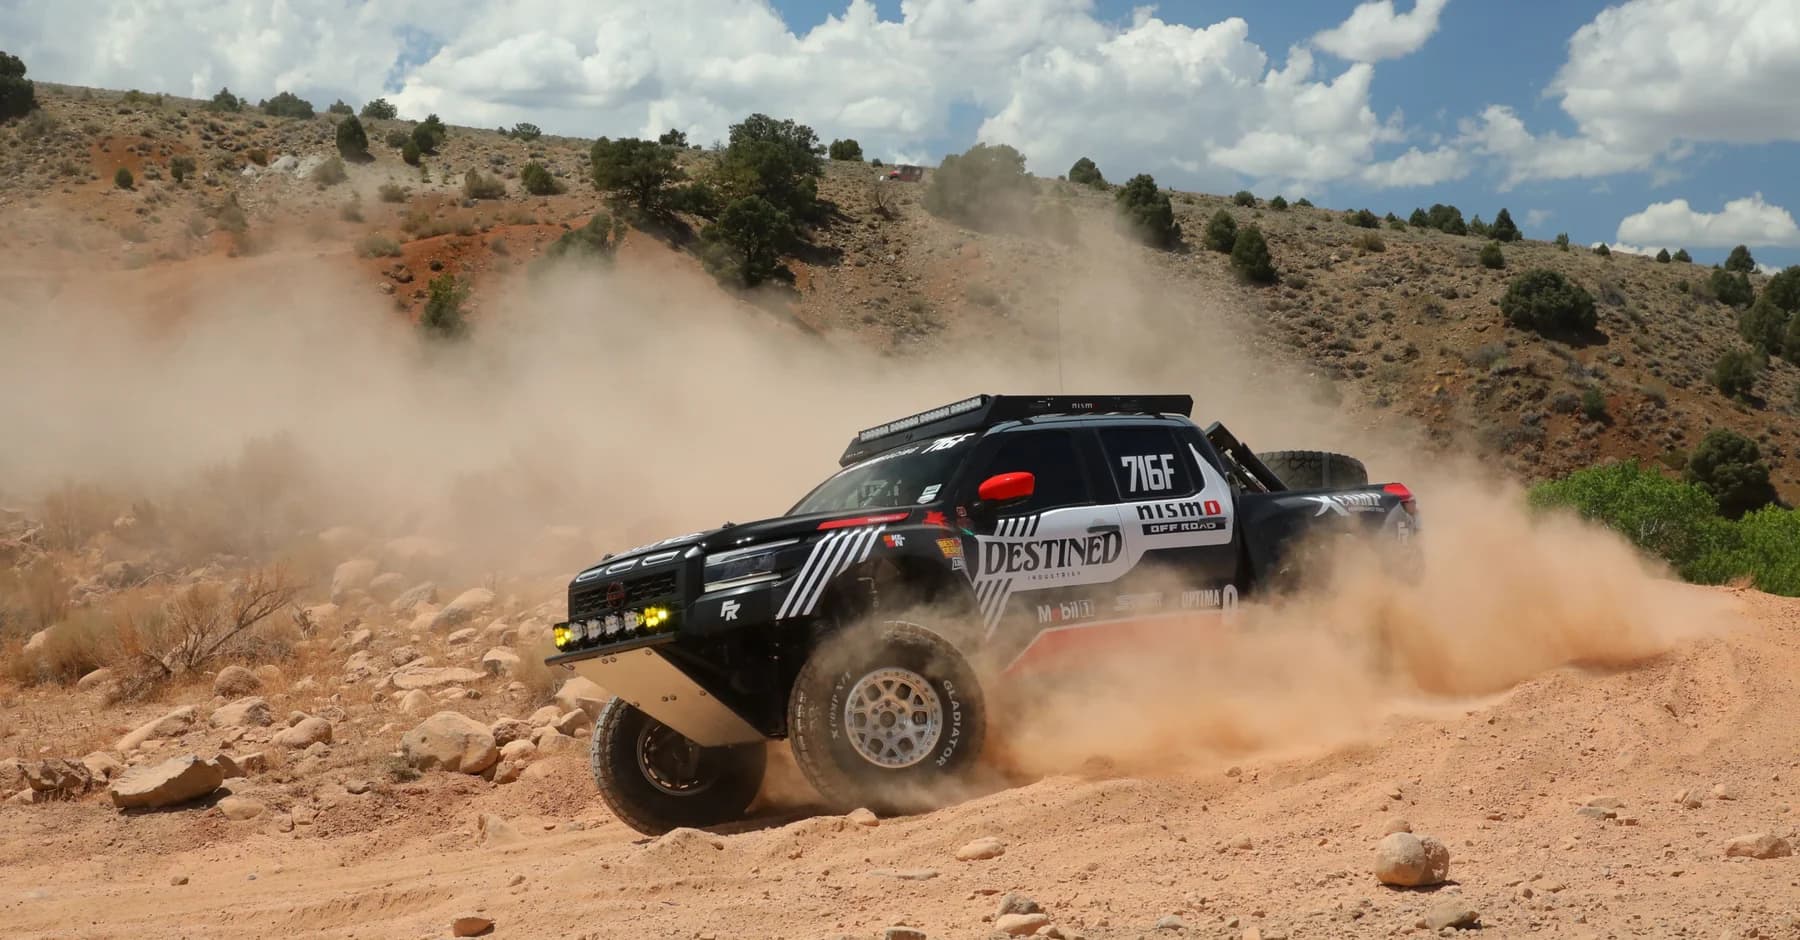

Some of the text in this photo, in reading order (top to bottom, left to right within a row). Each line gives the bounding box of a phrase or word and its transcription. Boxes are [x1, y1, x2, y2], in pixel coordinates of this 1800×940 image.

[1121, 454, 1175, 492] 716F
[1150, 522, 1217, 533] OFF ROAD
[984, 530, 1123, 576] DESTINED
[1037, 601, 1079, 623] Mobil
[1181, 589, 1220, 609] OPTIMA
[935, 679, 962, 767] GLADIATOR
